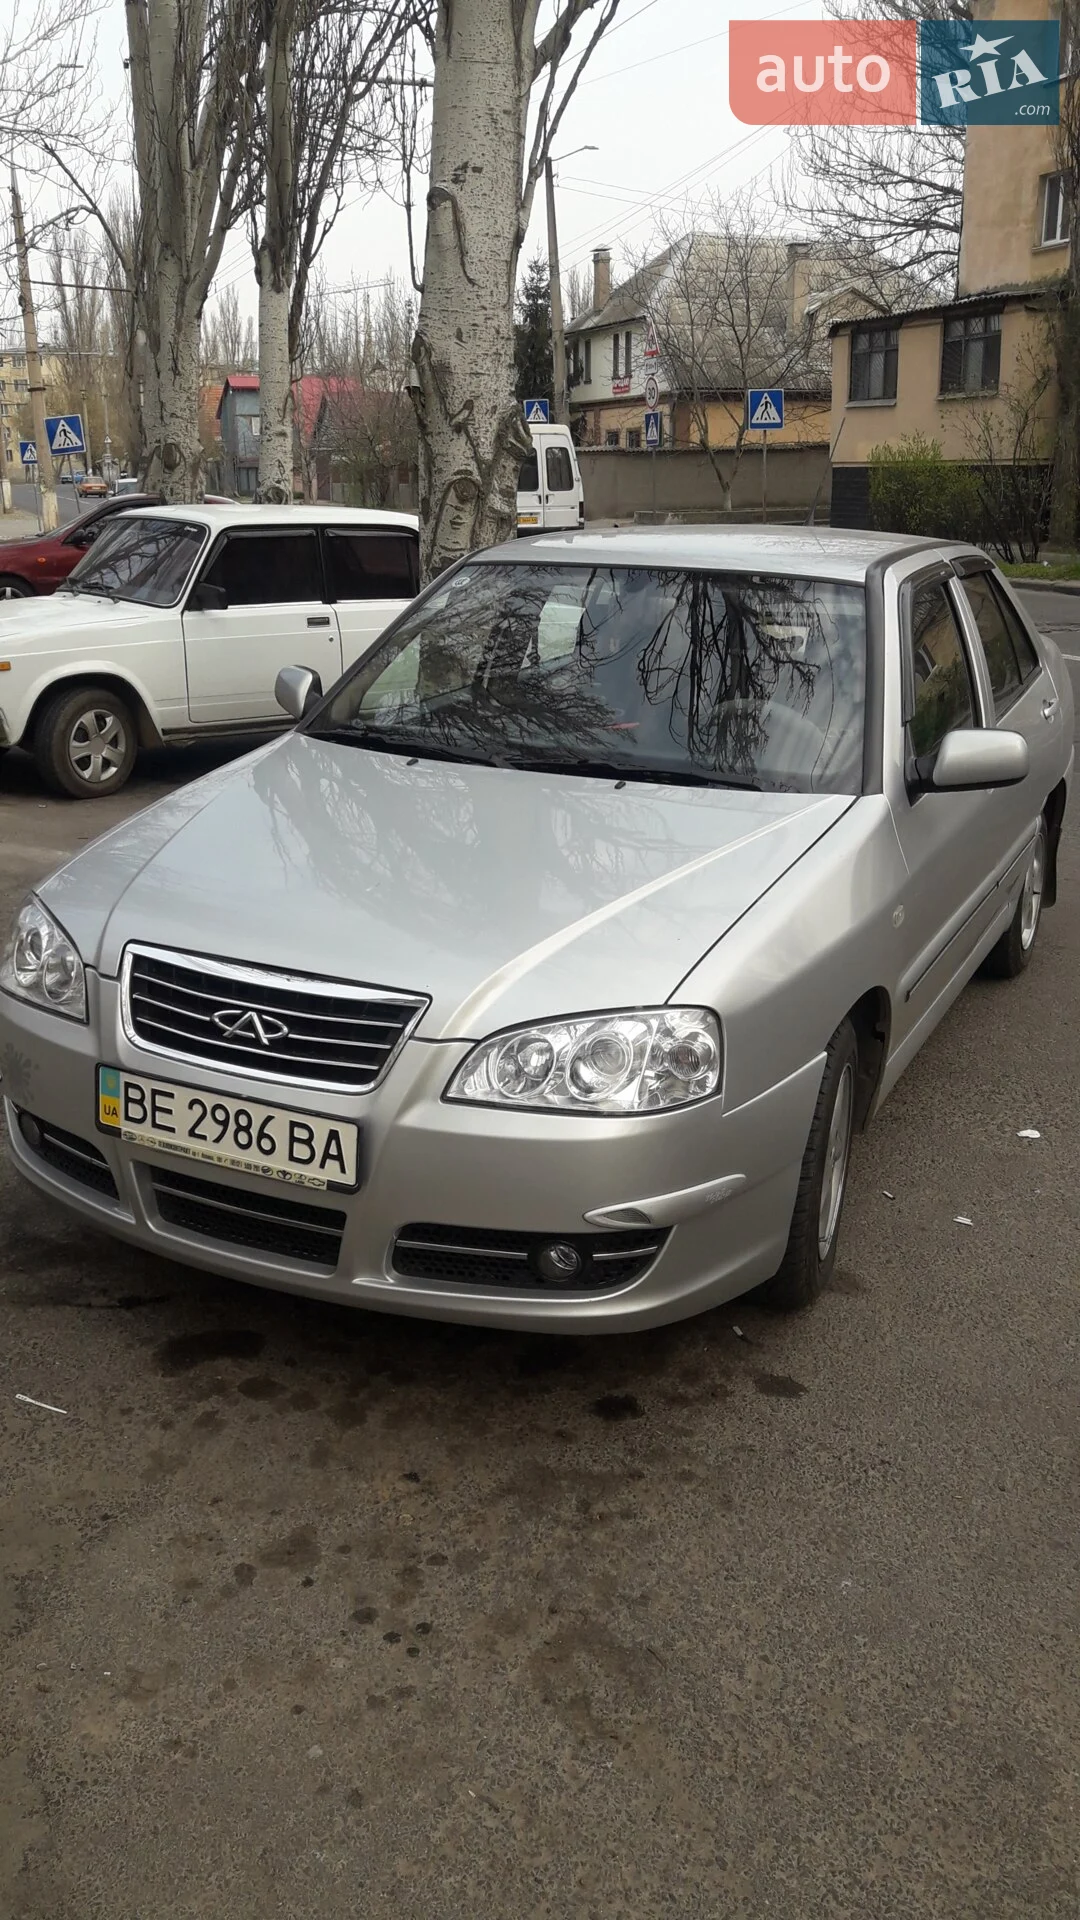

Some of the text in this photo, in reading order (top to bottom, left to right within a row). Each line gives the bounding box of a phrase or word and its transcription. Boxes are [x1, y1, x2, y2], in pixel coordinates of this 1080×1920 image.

[104, 1104, 118, 1119] UA
[124, 1081, 176, 1133] BE
[188, 1098, 276, 1155] 2986
[288, 1120, 347, 1174] BA
